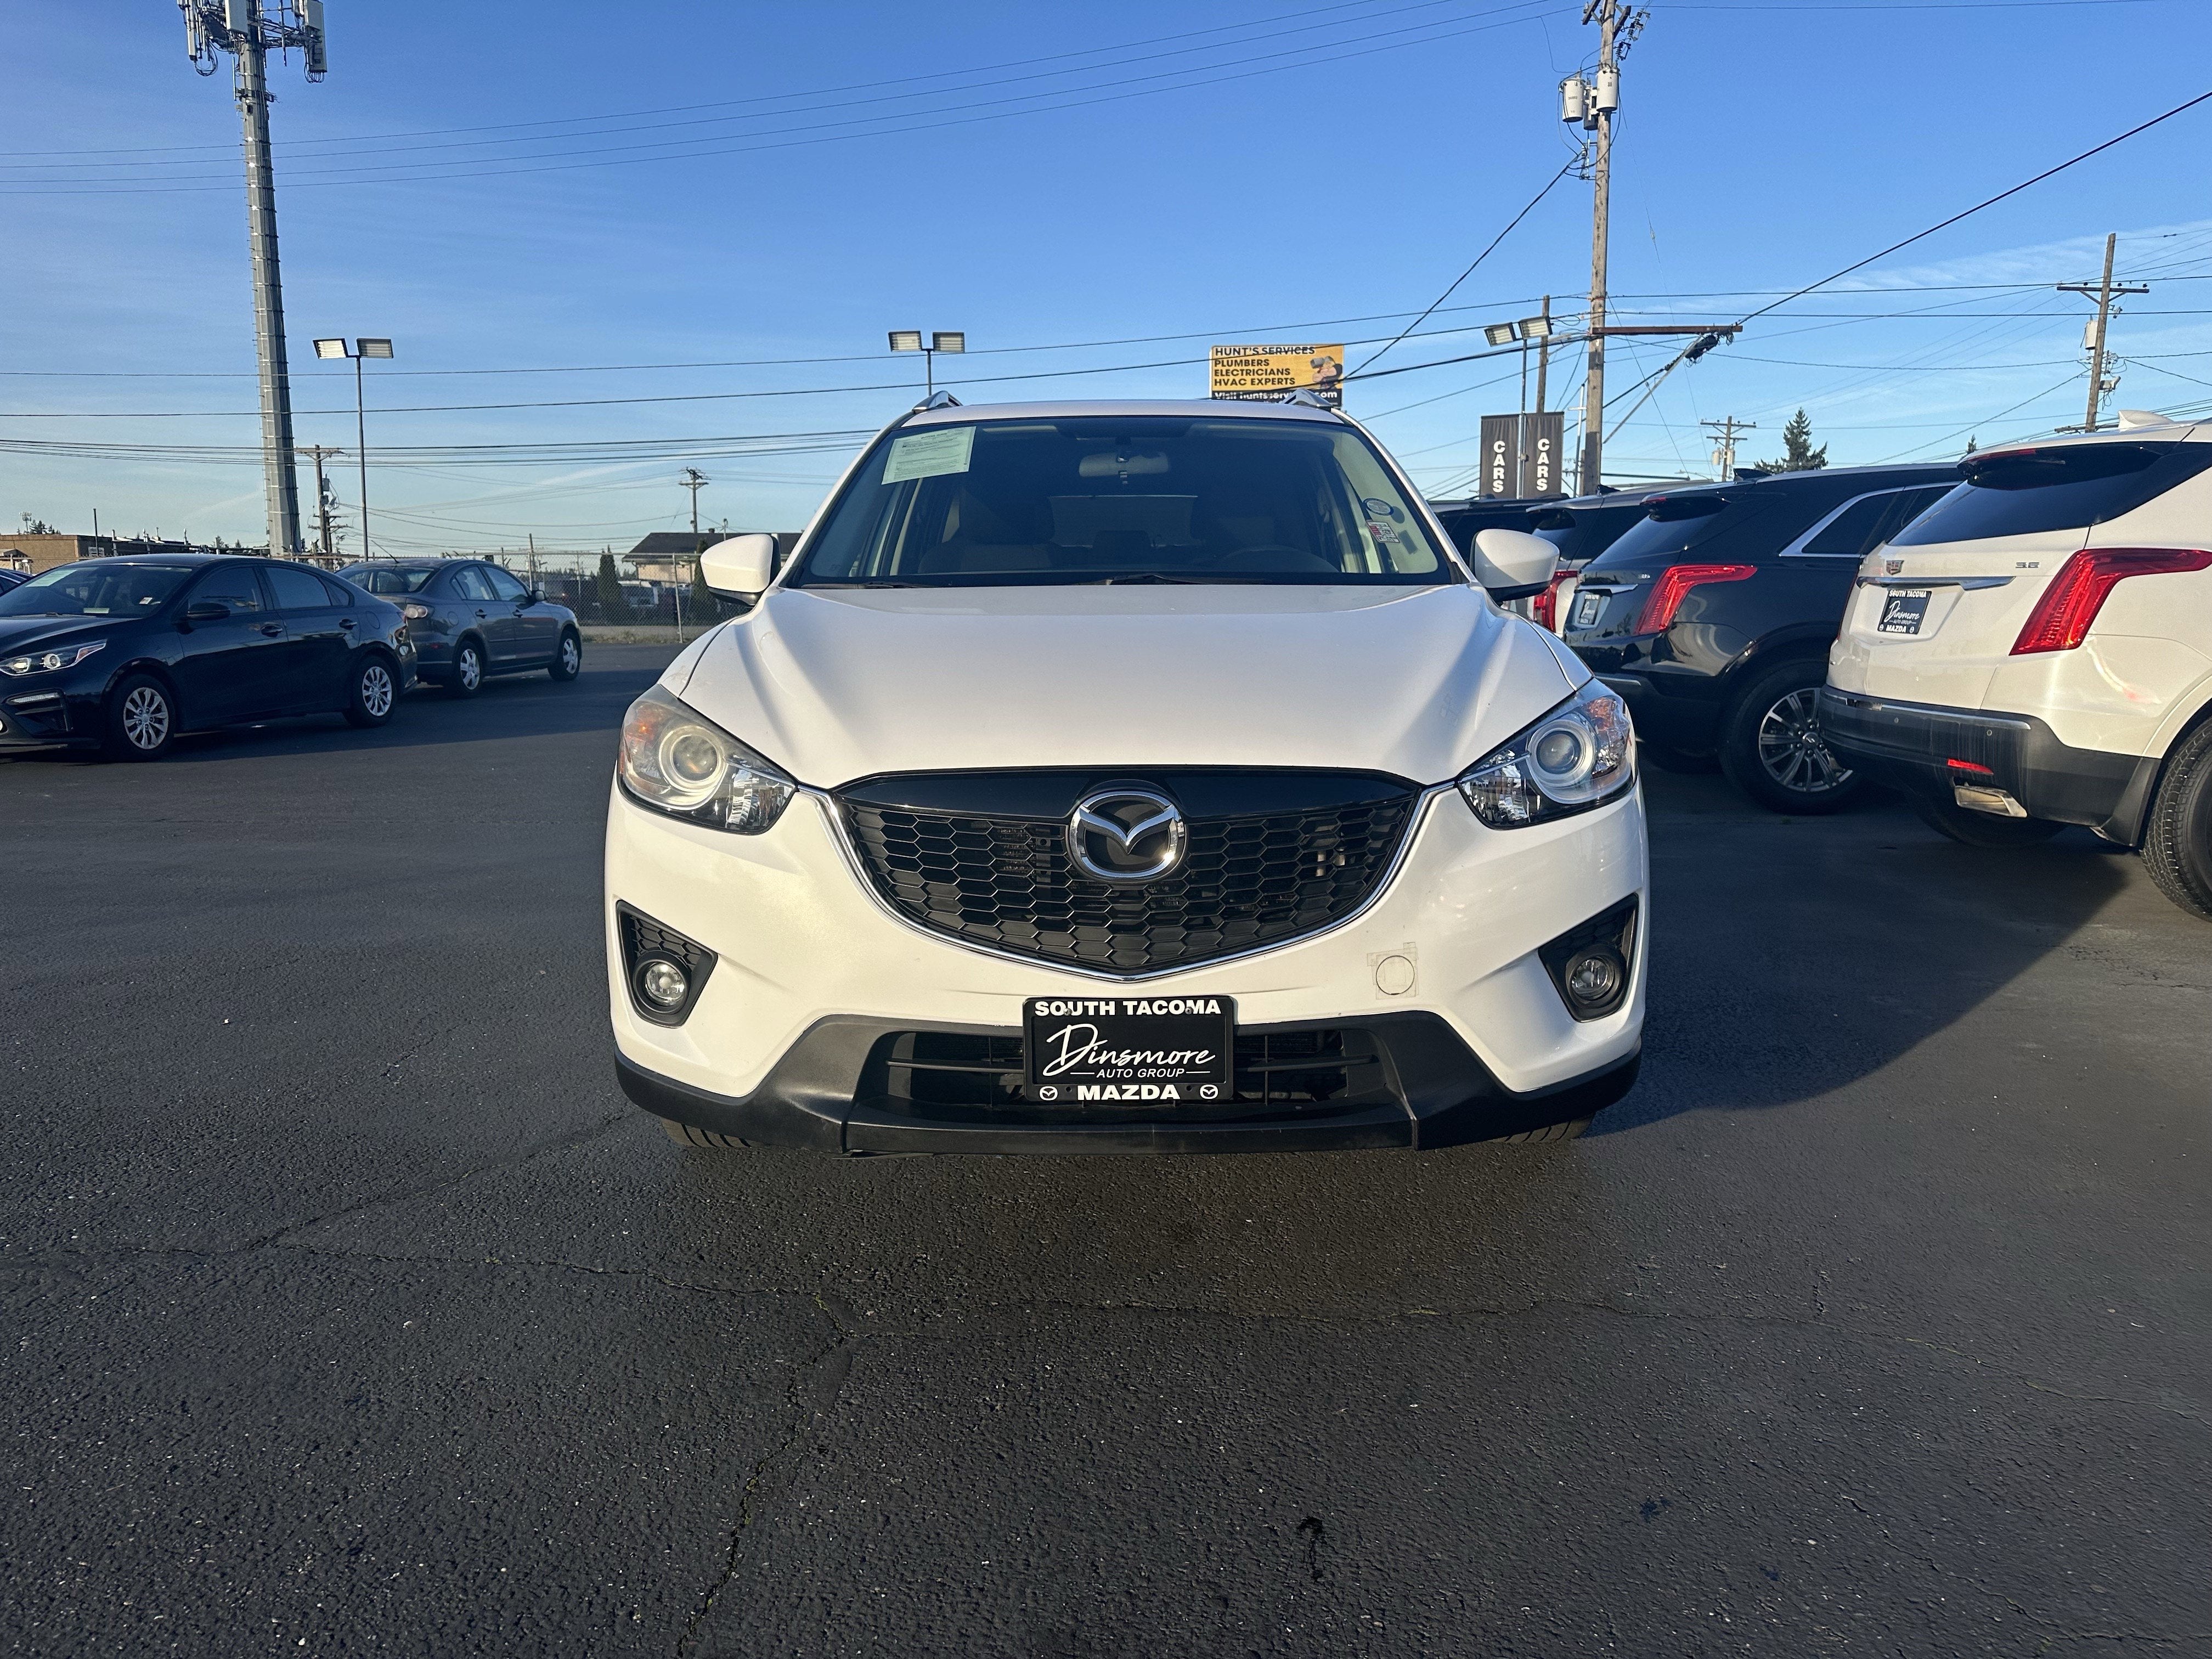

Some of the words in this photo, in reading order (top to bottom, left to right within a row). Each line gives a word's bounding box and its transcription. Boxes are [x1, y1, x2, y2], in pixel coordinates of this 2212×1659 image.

[1215, 347, 1259, 357] HUNT'S
[1261, 346, 1315, 355] SERVICES
[1214, 368, 1291, 377] ELECTRICIANS
[1214, 378, 1247, 386] HVAC
[1251, 377, 1295, 386] EXPERTS
[1492, 441, 1505, 493] CARS
[1536, 438, 1550, 491] CARS
[1883, 600, 1920, 622] Dinsmore
[1886, 625, 1907, 633] MAZDA
[1035, 1000, 1115, 1016] SOUTH
[1122, 999, 1221, 1015] TACOMA
[1042, 1023, 1216, 1076] Dinsmore
[1096, 1068, 1133, 1079] AUTO
[1137, 1068, 1185, 1078] GROUP
[1077, 1084, 1181, 1101] MAZDA
